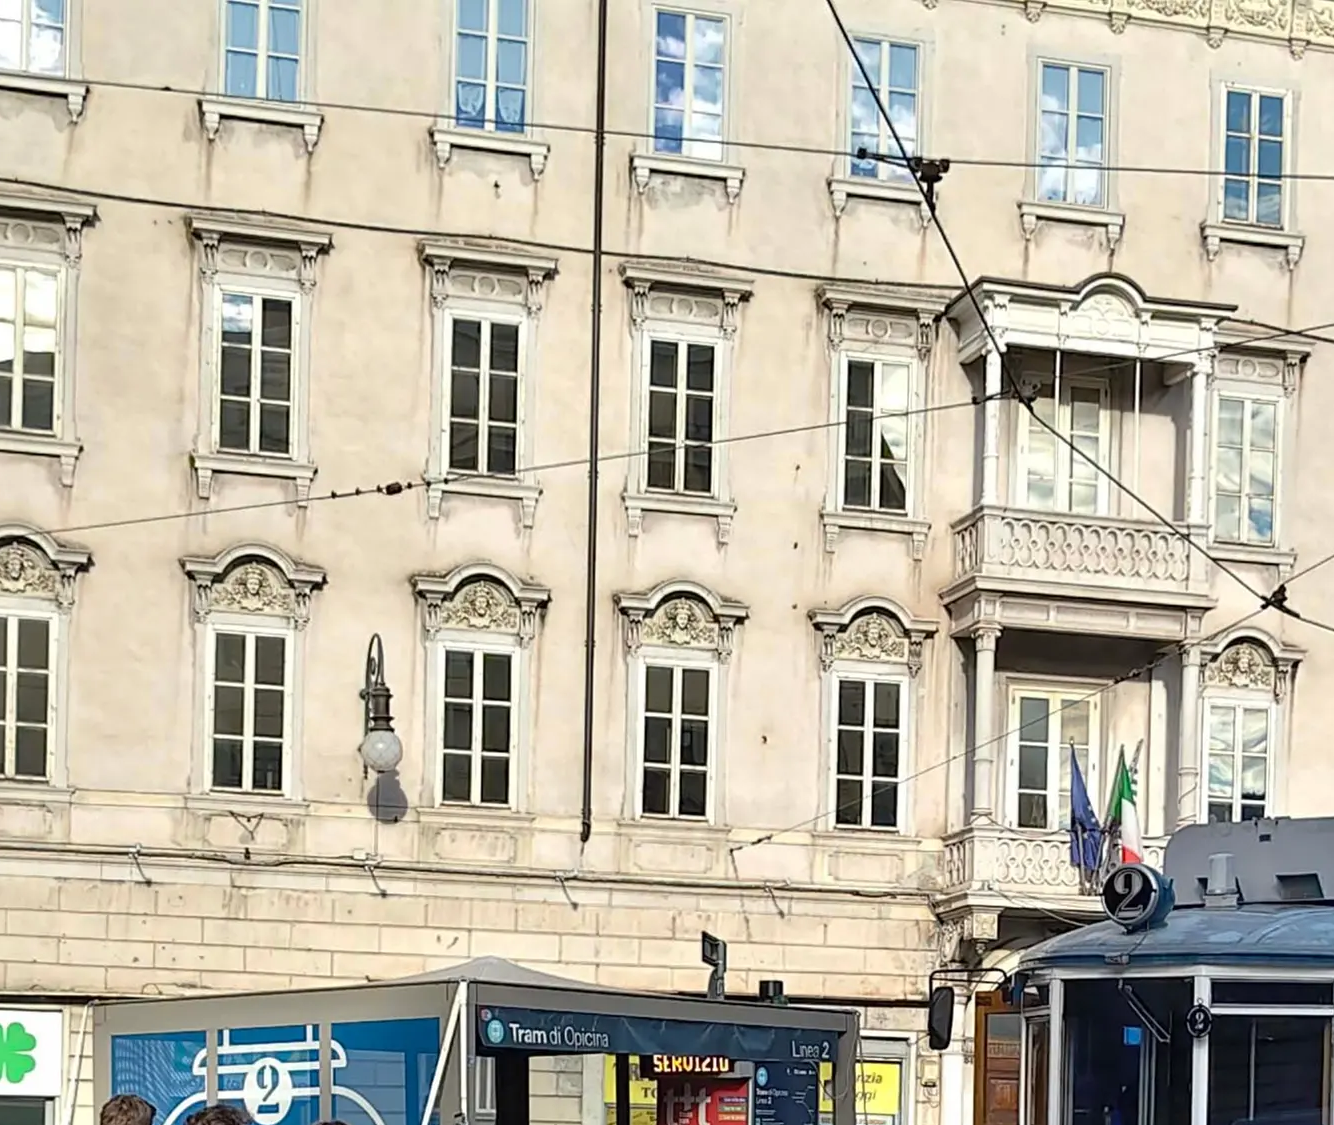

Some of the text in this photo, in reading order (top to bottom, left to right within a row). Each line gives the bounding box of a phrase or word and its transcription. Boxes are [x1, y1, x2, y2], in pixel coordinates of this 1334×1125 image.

[1113, 868, 1144, 919] 2
[1194, 1010, 1205, 1031] 2
[508, 1022, 609, 1052] Tram di Opicina
[791, 1040, 830, 1059] Linea 2
[255, 1063, 281, 1115] 2
